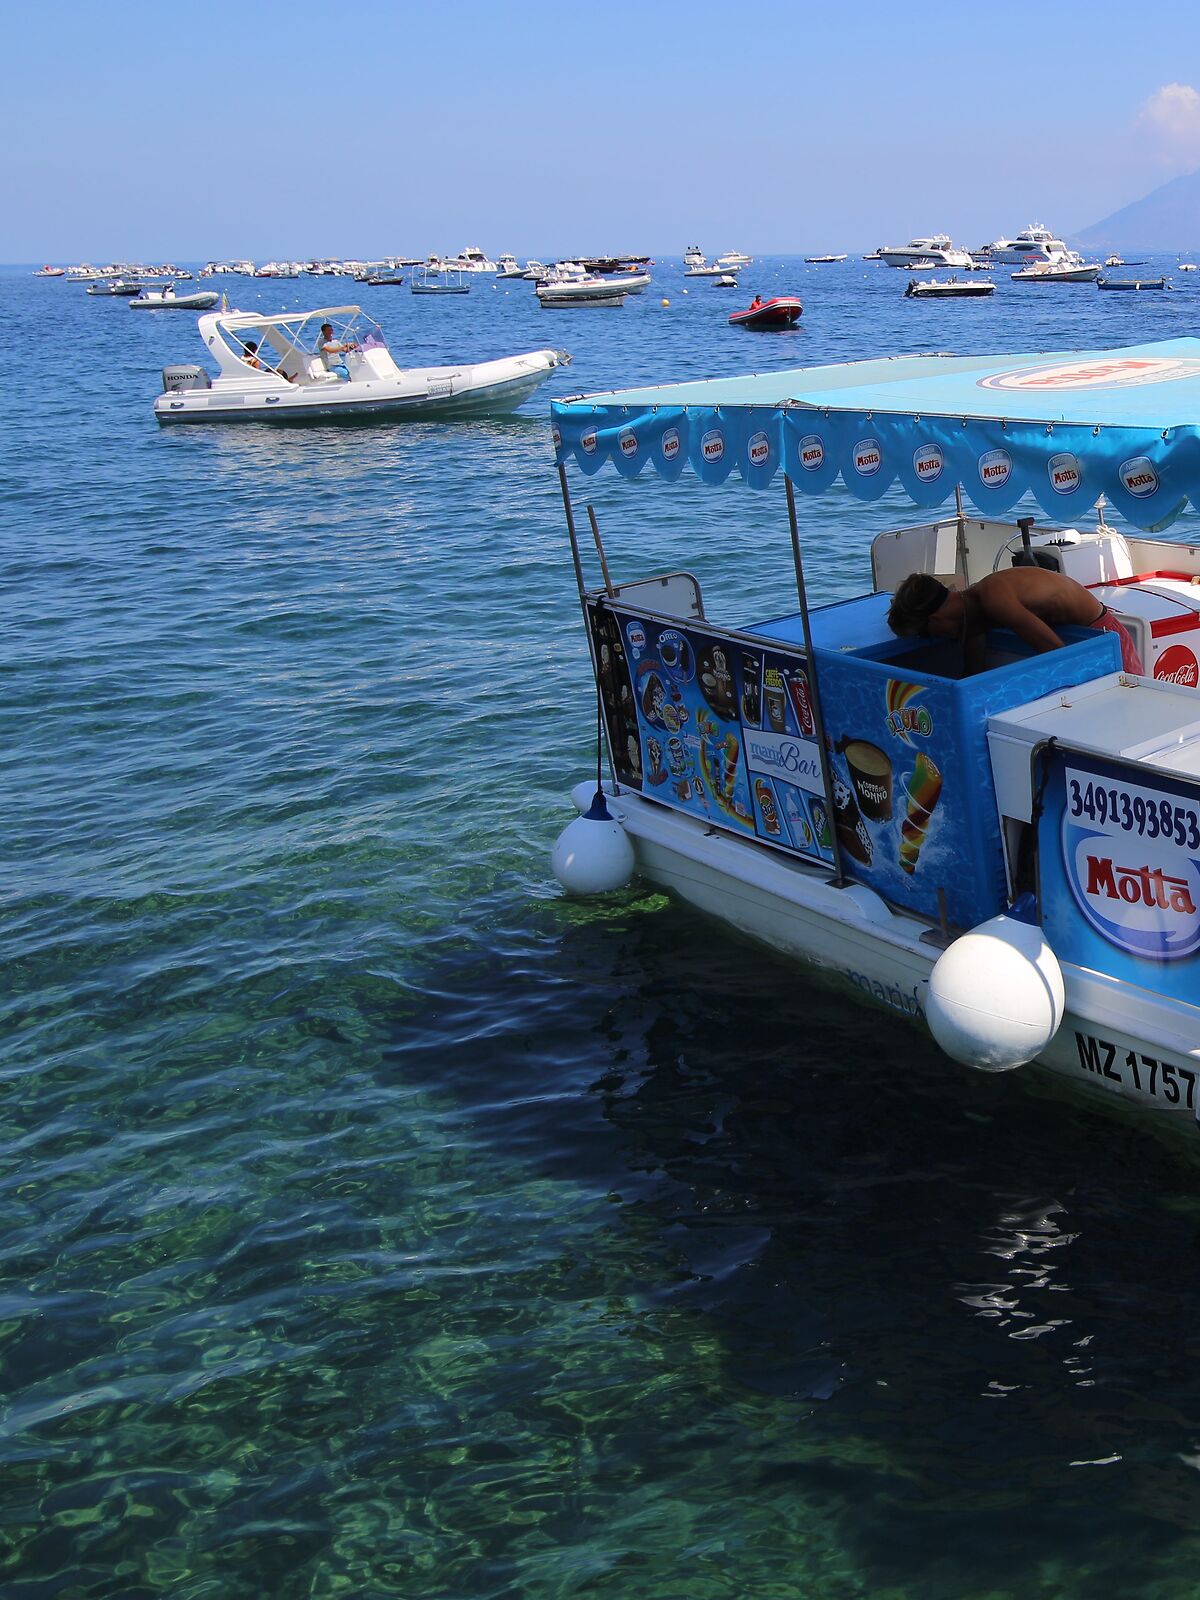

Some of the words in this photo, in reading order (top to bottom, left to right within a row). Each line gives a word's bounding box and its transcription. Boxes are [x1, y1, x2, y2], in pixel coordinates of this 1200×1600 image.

[704, 443, 722, 455] Motta
[803, 450, 822, 462] Motta
[857, 454, 879, 466] Motta
[918, 459, 940, 472] Motta
[983, 465, 1007, 478] Motta
[1054, 470, 1077, 484] Motta
[1126, 474, 1155, 488] Motta
[1069, 778, 1200, 850] 3491393853
[1086, 855, 1197, 914] Motta
[1074, 1031, 1122, 1083] MZ
[1125, 1050, 1196, 1109] 1757
